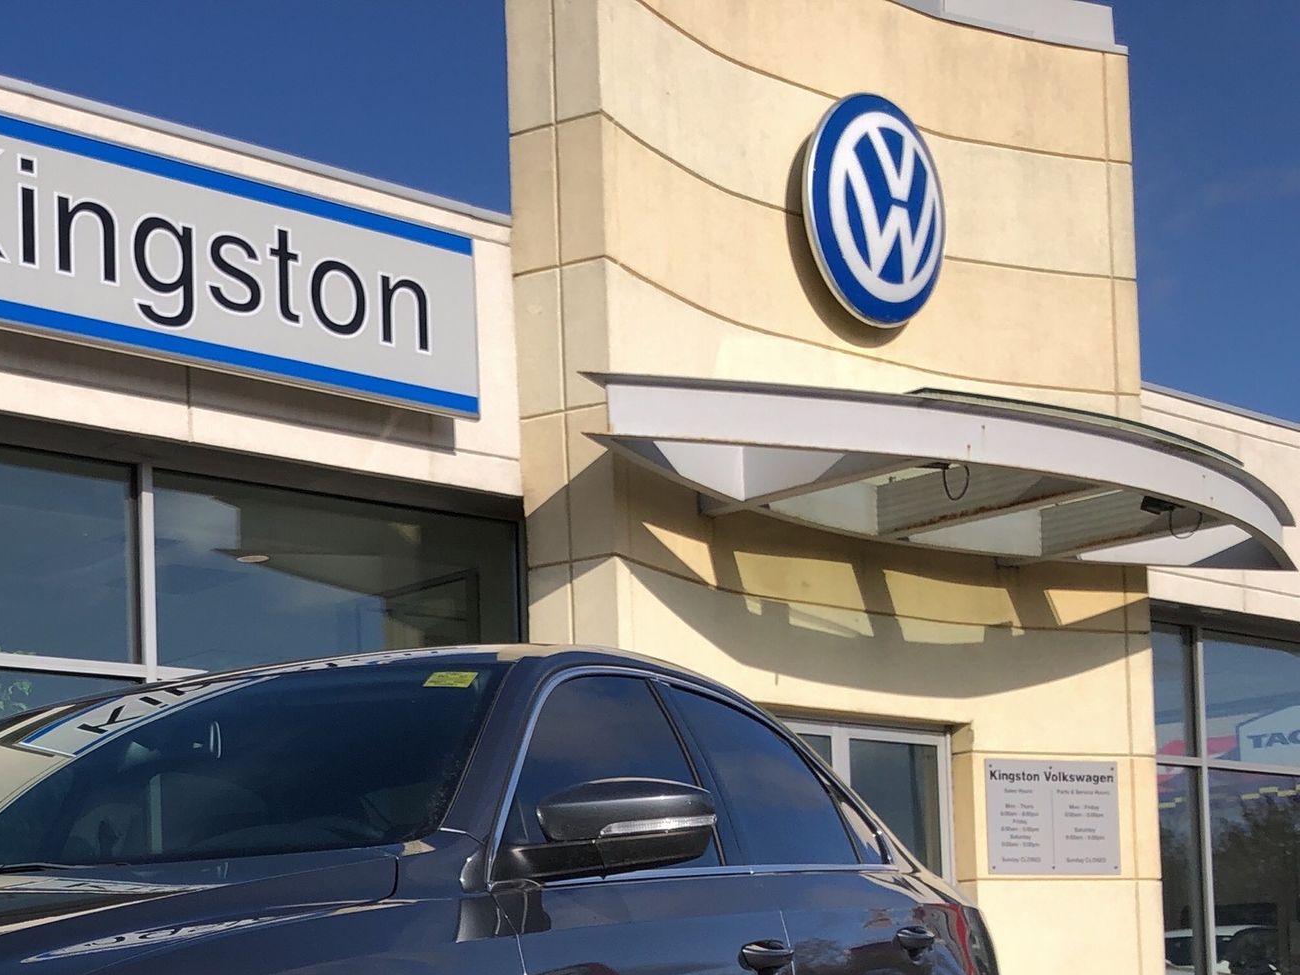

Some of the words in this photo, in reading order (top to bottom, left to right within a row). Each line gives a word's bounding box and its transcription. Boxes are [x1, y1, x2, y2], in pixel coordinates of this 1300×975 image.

[829, 111, 941, 303] VW
[989, 770, 1040, 783] Kingston
[1044, 771, 1114, 785] Volkswagen
